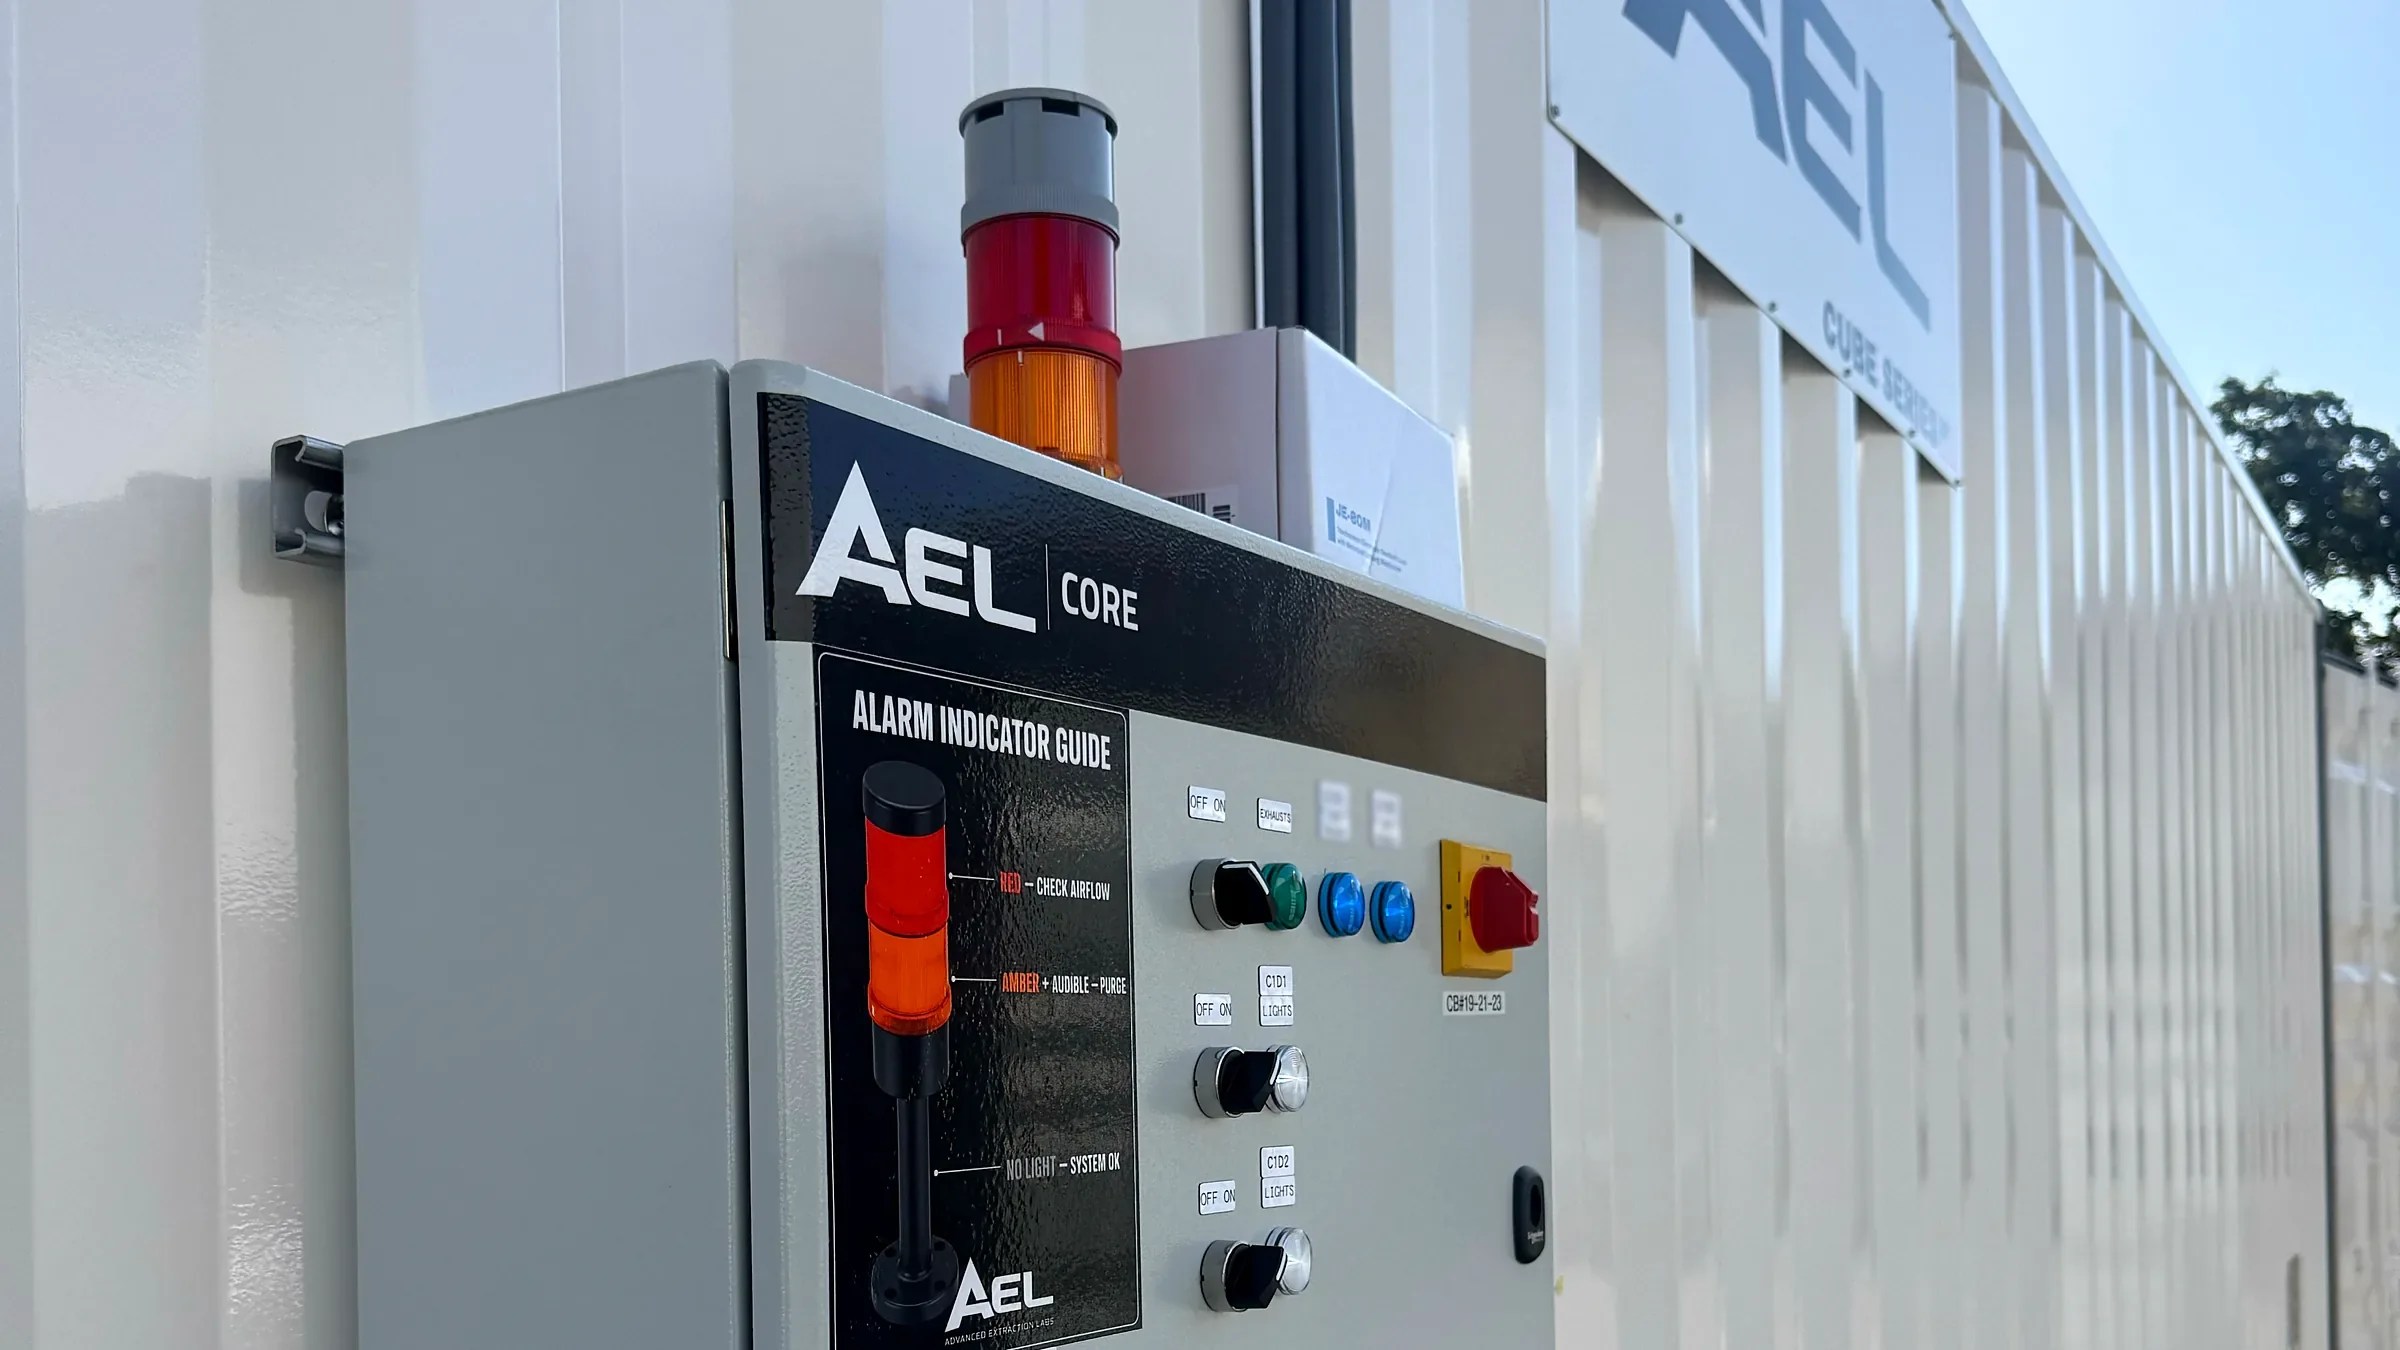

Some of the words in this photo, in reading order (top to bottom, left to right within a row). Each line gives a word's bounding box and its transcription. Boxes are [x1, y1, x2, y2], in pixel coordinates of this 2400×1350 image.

[1822, 299, 1877, 389] CUBE
[795, 459, 1037, 634] AEL
[1061, 571, 1139, 631] CORE
[852, 689, 934, 742] ALARM
[940, 705, 1050, 761] INDICATOR
[1055, 727, 1112, 771] GUIDE
[1190, 794, 1208, 811] OFF
[1213, 798, 1226, 813] ON
[1260, 808, 1291, 824] EXHAUSTS
[1000, 871, 1021, 894] RED
[1036, 877, 1069, 898] CHECK
[1070, 880, 1110, 901] AIRFLOW
[1002, 972, 1040, 993] AMBER
[1052, 975, 1089, 994] AUDIBLE
[1100, 977, 1127, 995] PURGE
[1265, 975, 1287, 988] C1D1
[1196, 1002, 1214, 1017] OFF
[1219, 1002, 1232, 1017] ON
[1262, 1005, 1293, 1017] LIGHTS
[1446, 994, 1502, 1012] CB#19-21-23
[1006, 1158, 1023, 1181] NO
[1025, 1155, 1056, 1179] LIGHT
[1070, 1153, 1106, 1175] SYSTEM
[1108, 1151, 1121, 1171] OK
[1267, 1154, 1289, 1170] C1D2
[1200, 1190, 1218, 1206] OFF
[1223, 1188, 1236, 1204] ON
[1264, 1184, 1295, 1199] LIGHTS
[944, 1256, 1054, 1333] AEL
[944, 1330, 986, 1346] ADVANCED
[988, 1322, 1034, 1338] EXTRACTION
[1036, 1316, 1055, 1328] LABS
